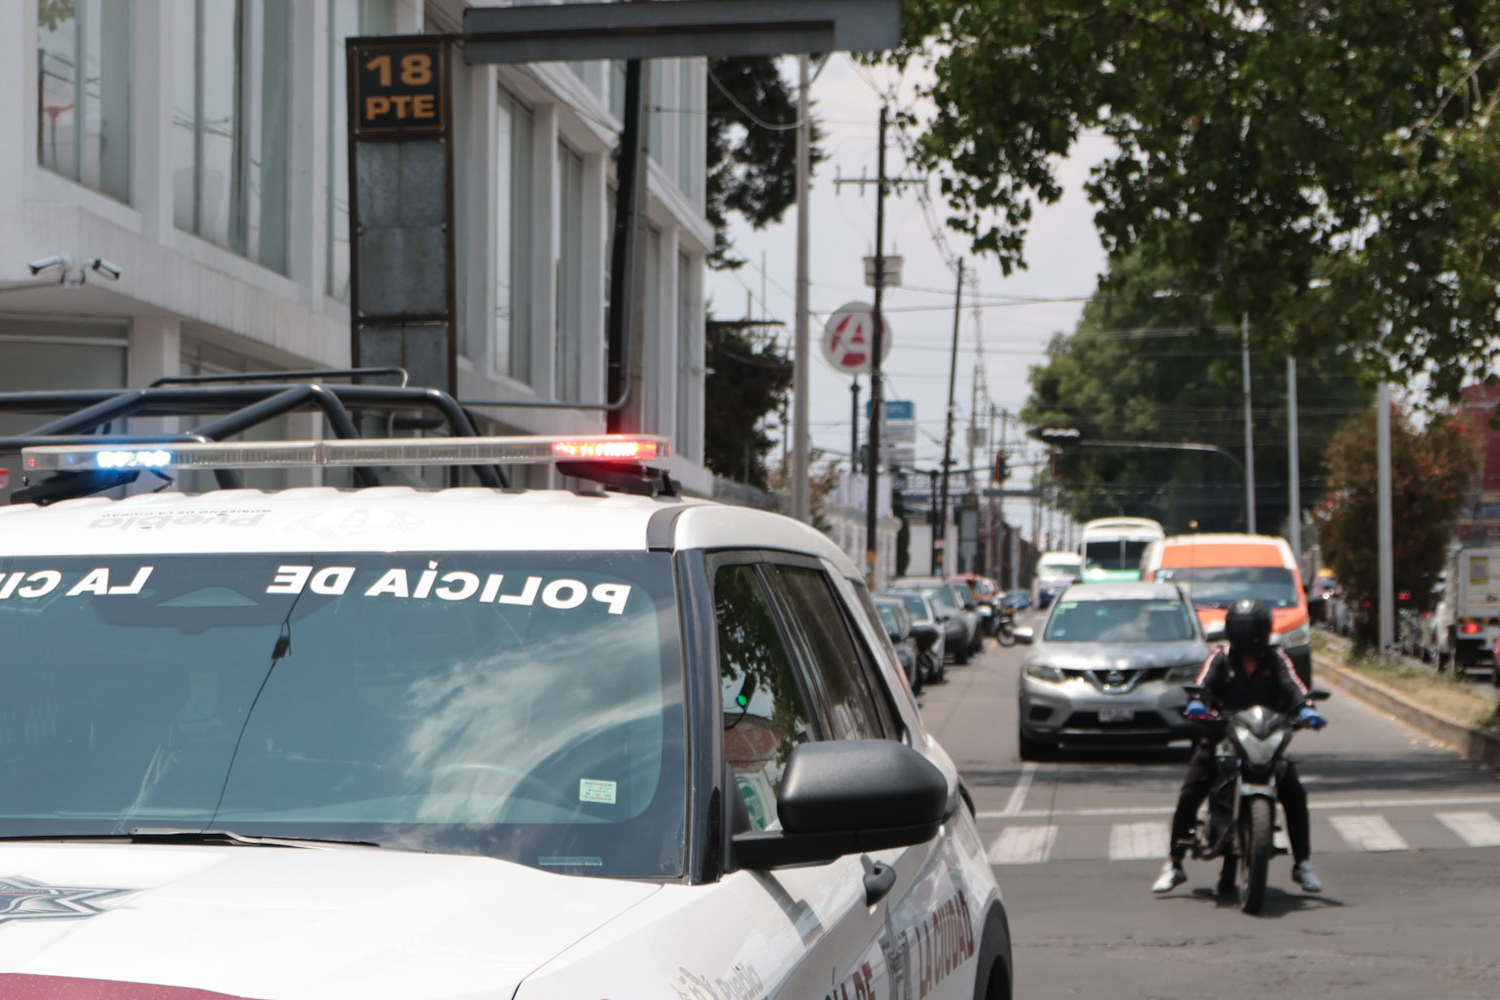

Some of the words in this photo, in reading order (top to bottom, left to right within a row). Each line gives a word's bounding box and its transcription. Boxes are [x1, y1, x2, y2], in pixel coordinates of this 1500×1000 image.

[365, 53, 432, 87] 18
[366, 94, 435, 120] PTE
[933, 890, 974, 985] CIUDAD
